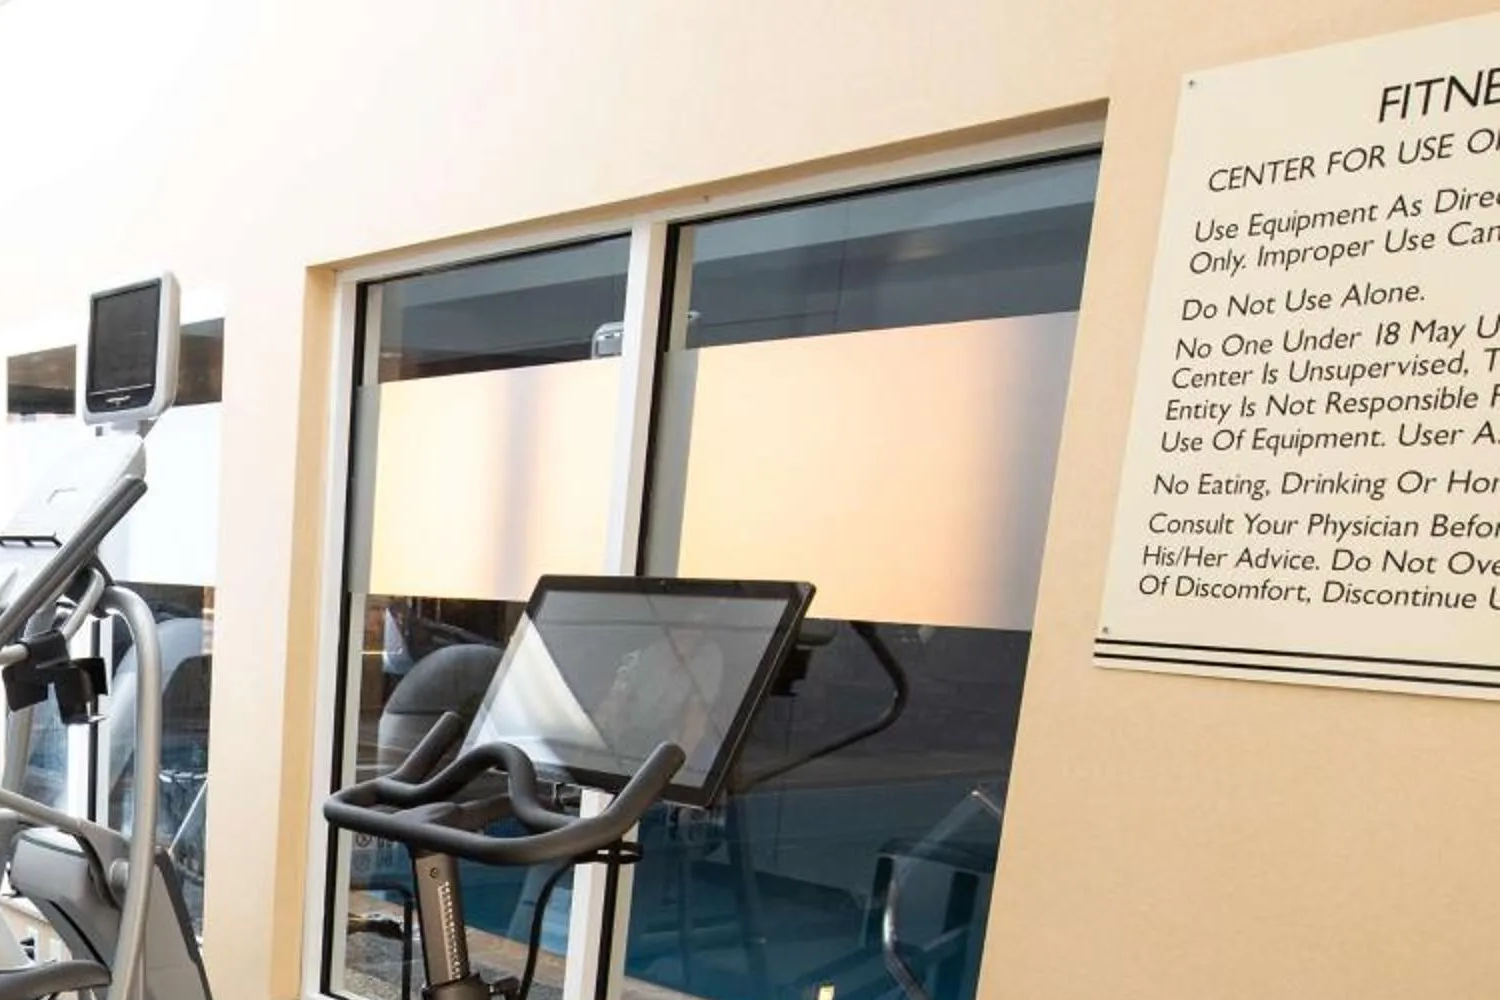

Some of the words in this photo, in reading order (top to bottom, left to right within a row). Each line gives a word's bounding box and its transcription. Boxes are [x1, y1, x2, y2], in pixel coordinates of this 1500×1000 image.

[1207, 154, 1317, 193] CENTER
[1326, 144, 1387, 176] FOR
[1397, 131, 1456, 165] USE
[1466, 127, 1500, 155] O
[1194, 218, 1240, 244] Use
[1247, 204, 1379, 243] Equipment
[1385, 193, 1423, 221] As
[1433, 186, 1500, 215] Dire
[1188, 247, 1247, 279] Only.
[1256, 239, 1376, 273] Improper
[1384, 226, 1437, 255] Use
[1181, 298, 1219, 322] Do
[1226, 293, 1277, 319] Not
[1284, 287, 1334, 314] Use
[1339, 281, 1426, 309] Alone.
[1175, 336, 1214, 361] No
[1220, 332, 1274, 358] One
[1282, 325, 1363, 354] Under
[1375, 320, 1402, 348] 18
[1409, 319, 1467, 350] May
[1171, 366, 1255, 390] Center
[1260, 361, 1280, 386] Is
[1164, 398, 1233, 427] Entity
[1239, 394, 1257, 419] Is
[1264, 392, 1317, 417] Not
[1324, 384, 1480, 421] Responsible
[1160, 429, 1204, 454] Use
[1211, 427, 1248, 452] Of
[1251, 426, 1387, 458] Equipment.
[1397, 421, 1466, 448] User
[1152, 472, 1190, 496] No
[1197, 472, 1272, 502] Eating,
[1280, 470, 1389, 502] Drinking
[1396, 469, 1438, 495] Or
[1148, 511, 1236, 536] Consult
[1243, 512, 1300, 536] Your
[1306, 512, 1420, 544] Physician
[1142, 544, 1229, 569] His/Her
[1232, 545, 1321, 572] Advice.
[1330, 547, 1373, 573] Do
[1381, 548, 1439, 575] Not
[1138, 573, 1172, 597] Of
[1174, 574, 1312, 605] Discomfort,
[1321, 579, 1478, 610] Discontinue
